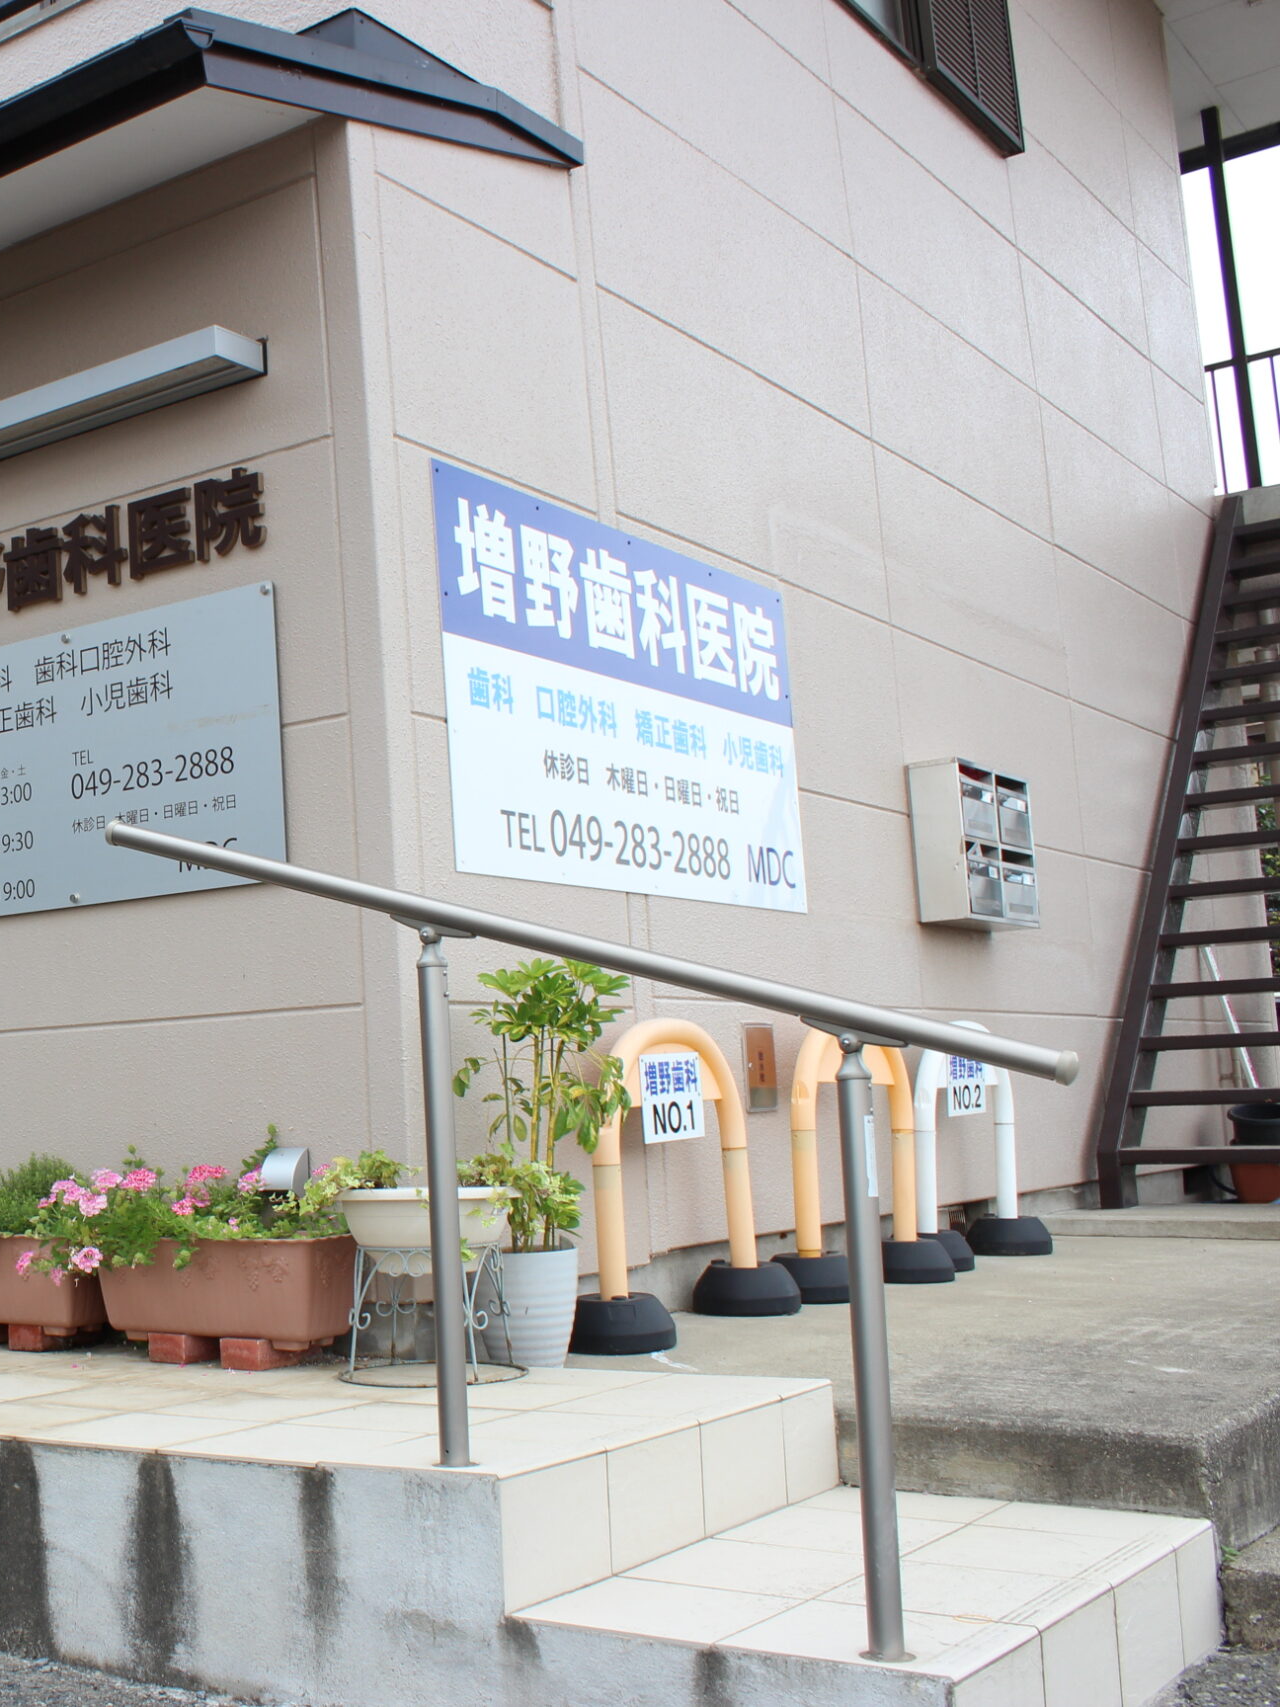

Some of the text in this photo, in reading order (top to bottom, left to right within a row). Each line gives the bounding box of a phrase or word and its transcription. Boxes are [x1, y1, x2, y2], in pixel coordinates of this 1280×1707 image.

[453, 497, 780, 701] 増野歯科医院
[34, 627, 172, 685] 歯科口腔外科
[81, 670, 174, 717] 小児歯科
[467, 666, 785, 778] 歯科 口腔外科 矯正歯科 小児歯科
[71, 746, 235, 800] 049-283-2888
[72, 750, 94, 766] TEL
[543, 749, 740, 815] 休診日 木曜日・日曜日・祝日
[72, 815, 106, 834] 休診日
[500, 809, 797, 889] TEL 049-283-2888 MDC
[644, 1058, 698, 1097] 増野歯科
[952, 1084, 982, 1111] NO.2
[652, 1099, 695, 1136] NO.1
